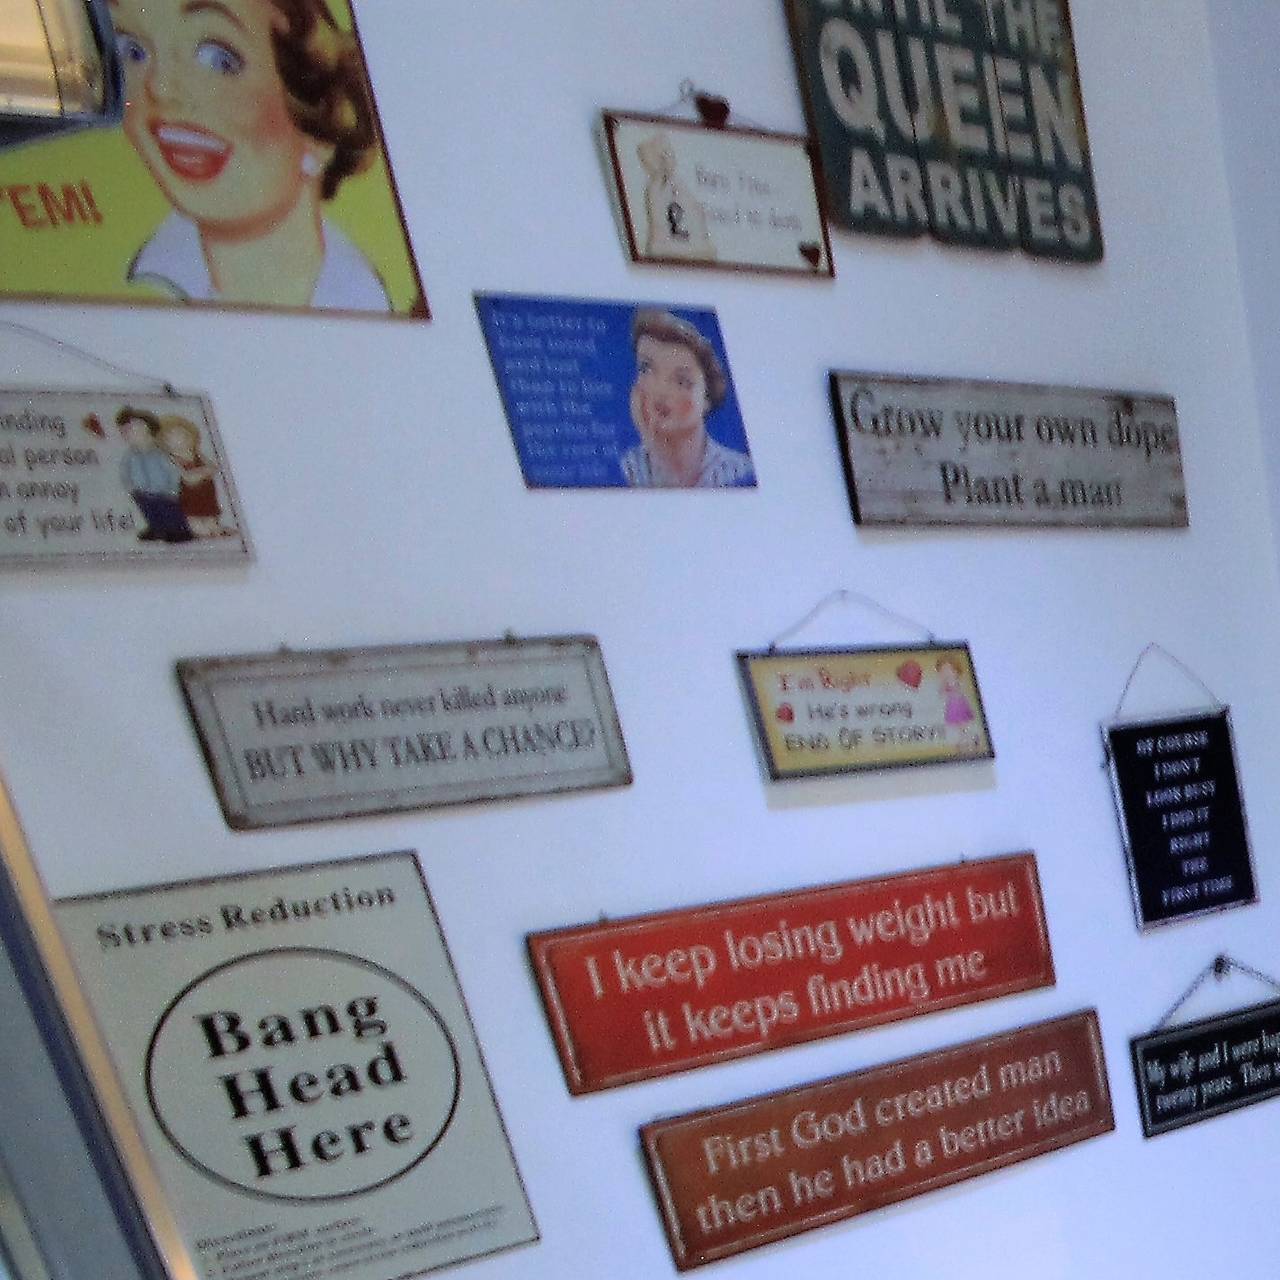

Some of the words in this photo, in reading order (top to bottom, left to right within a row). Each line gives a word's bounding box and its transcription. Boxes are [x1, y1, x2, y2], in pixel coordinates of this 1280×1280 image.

[819, 16, 1084, 169] QUEEN
[849, 148, 1092, 245] ARRIVES
[851, 387, 943, 438] Grow
[955, 412, 1023, 452] your
[1035, 415, 1098, 448] own
[1108, 408, 1174, 461] dope
[24, 448, 99, 471] person
[940, 461, 1024, 506] Plant
[1033, 478, 1051, 506] a
[1059, 477, 1122, 507] man
[4, 509, 27, 533] of
[36, 513, 83, 539] your
[17, 481, 80, 505] annoy
[252, 693, 316, 731] Hard
[319, 693, 374, 723] work
[379, 697, 438, 720] never
[439, 687, 498, 713] killed
[784, 732, 830, 752] END
[838, 727, 861, 751] OF
[1156, 729, 1208, 753] COURSE
[244, 744, 306, 783] BUT
[310, 738, 380, 775] WHY
[385, 730, 456, 768] TAKE
[461, 732, 481, 760] A
[96, 913, 213, 949] Stress
[219, 884, 396, 934] Reduction
[585, 957, 604, 997] I
[613, 941, 716, 986] keep
[726, 917, 844, 971] losing
[848, 889, 961, 945] weight
[967, 883, 1021, 920] but
[193, 993, 390, 1060] Bang
[642, 1010, 676, 1052] it
[682, 988, 798, 1039] keeps
[805, 961, 930, 1016] finding
[934, 949, 987, 985] me
[217, 1040, 408, 1121] Head
[1146, 1059, 1165, 1090] My
[1170, 1051, 1196, 1083] wife
[1199, 1043, 1220, 1072] and
[1223, 1041, 1228, 1064] I
[1231, 1039, 1260, 1060] were
[1156, 1085, 1197, 1112] twenty
[1240, 1061, 1272, 1086] Then
[240, 1111, 416, 1178] Here
[702, 1126, 786, 1175] First
[791, 1100, 869, 1149] God
[875, 1064, 993, 1126] created
[998, 1049, 1062, 1088] man
[695, 1186, 782, 1234] then
[788, 1166, 834, 1199] he
[841, 1140, 904, 1187] had
[913, 1138, 933, 1167] a
[939, 1108, 1026, 1156] better
[1031, 1088, 1091, 1130] idea
